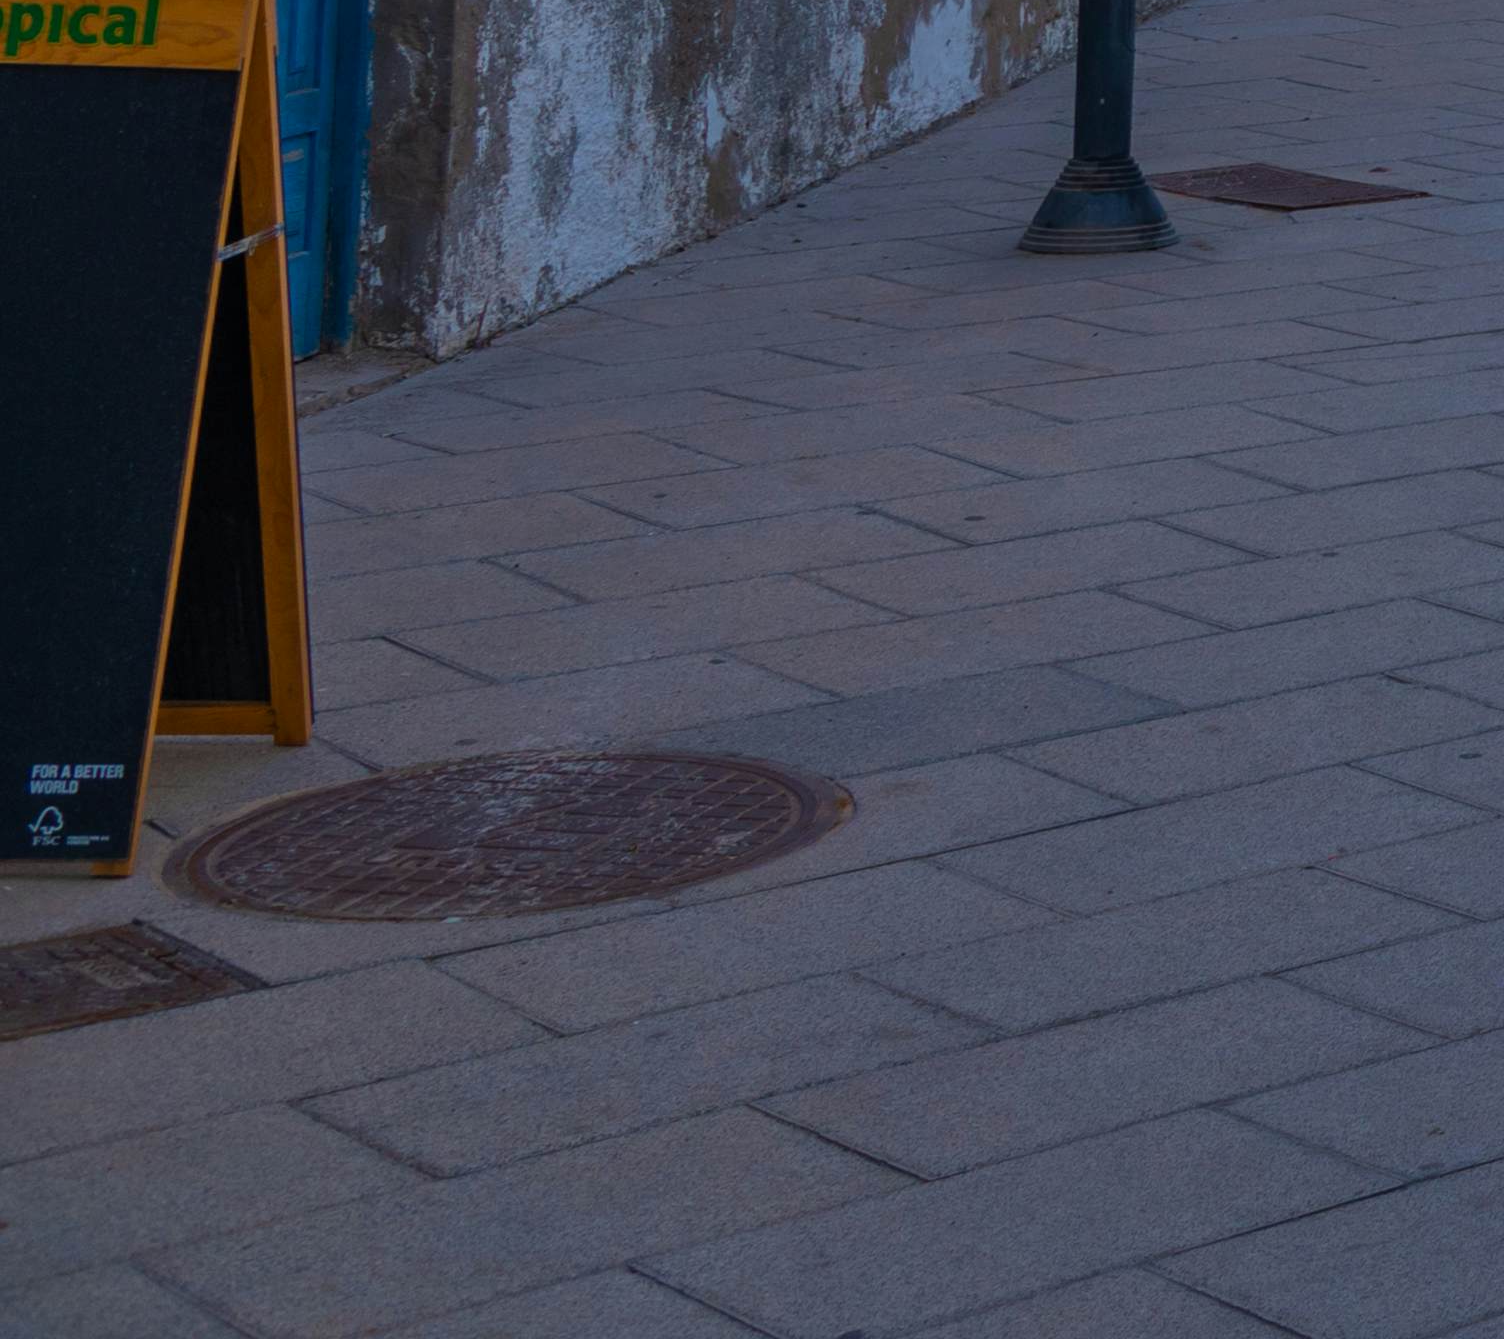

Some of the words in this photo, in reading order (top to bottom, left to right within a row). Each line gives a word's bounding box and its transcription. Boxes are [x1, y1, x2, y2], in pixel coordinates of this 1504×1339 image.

[31, 764, 59, 779] FOR
[60, 764, 71, 779] A
[73, 764, 125, 779] BETTER
[30, 780, 79, 794] WORLD
